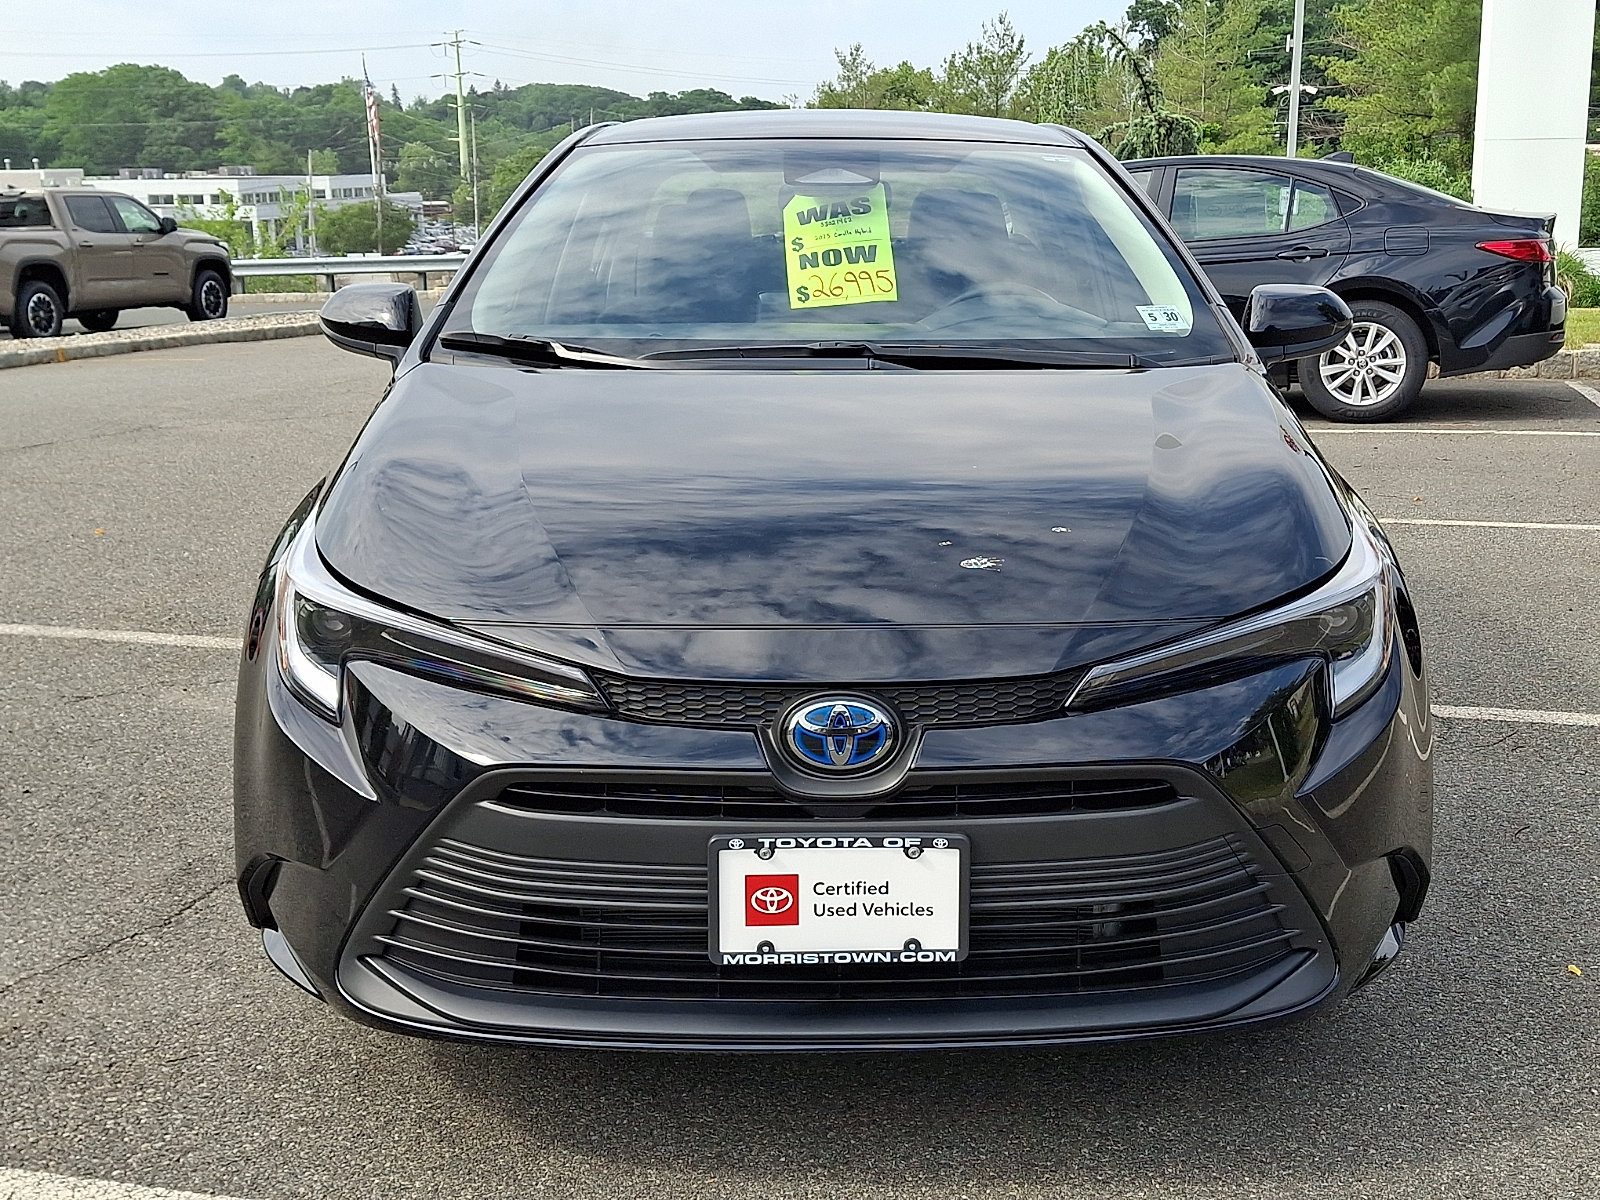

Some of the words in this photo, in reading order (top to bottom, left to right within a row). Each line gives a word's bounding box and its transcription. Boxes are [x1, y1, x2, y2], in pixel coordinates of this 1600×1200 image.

[796, 197, 872, 226] WAS
[791, 237, 804, 252] $
[799, 244, 878, 270] NOW
[1148, 312, 1157, 321] 5
[1163, 312, 1178, 321] 30
[757, 837, 880, 848] TOYOTA
[882, 837, 922, 848] OF
[813, 880, 889, 896] Certified
[813, 903, 857, 917] Used
[862, 902, 934, 917] Vehicles
[722, 951, 957, 965] MORRISTOWN.COM
